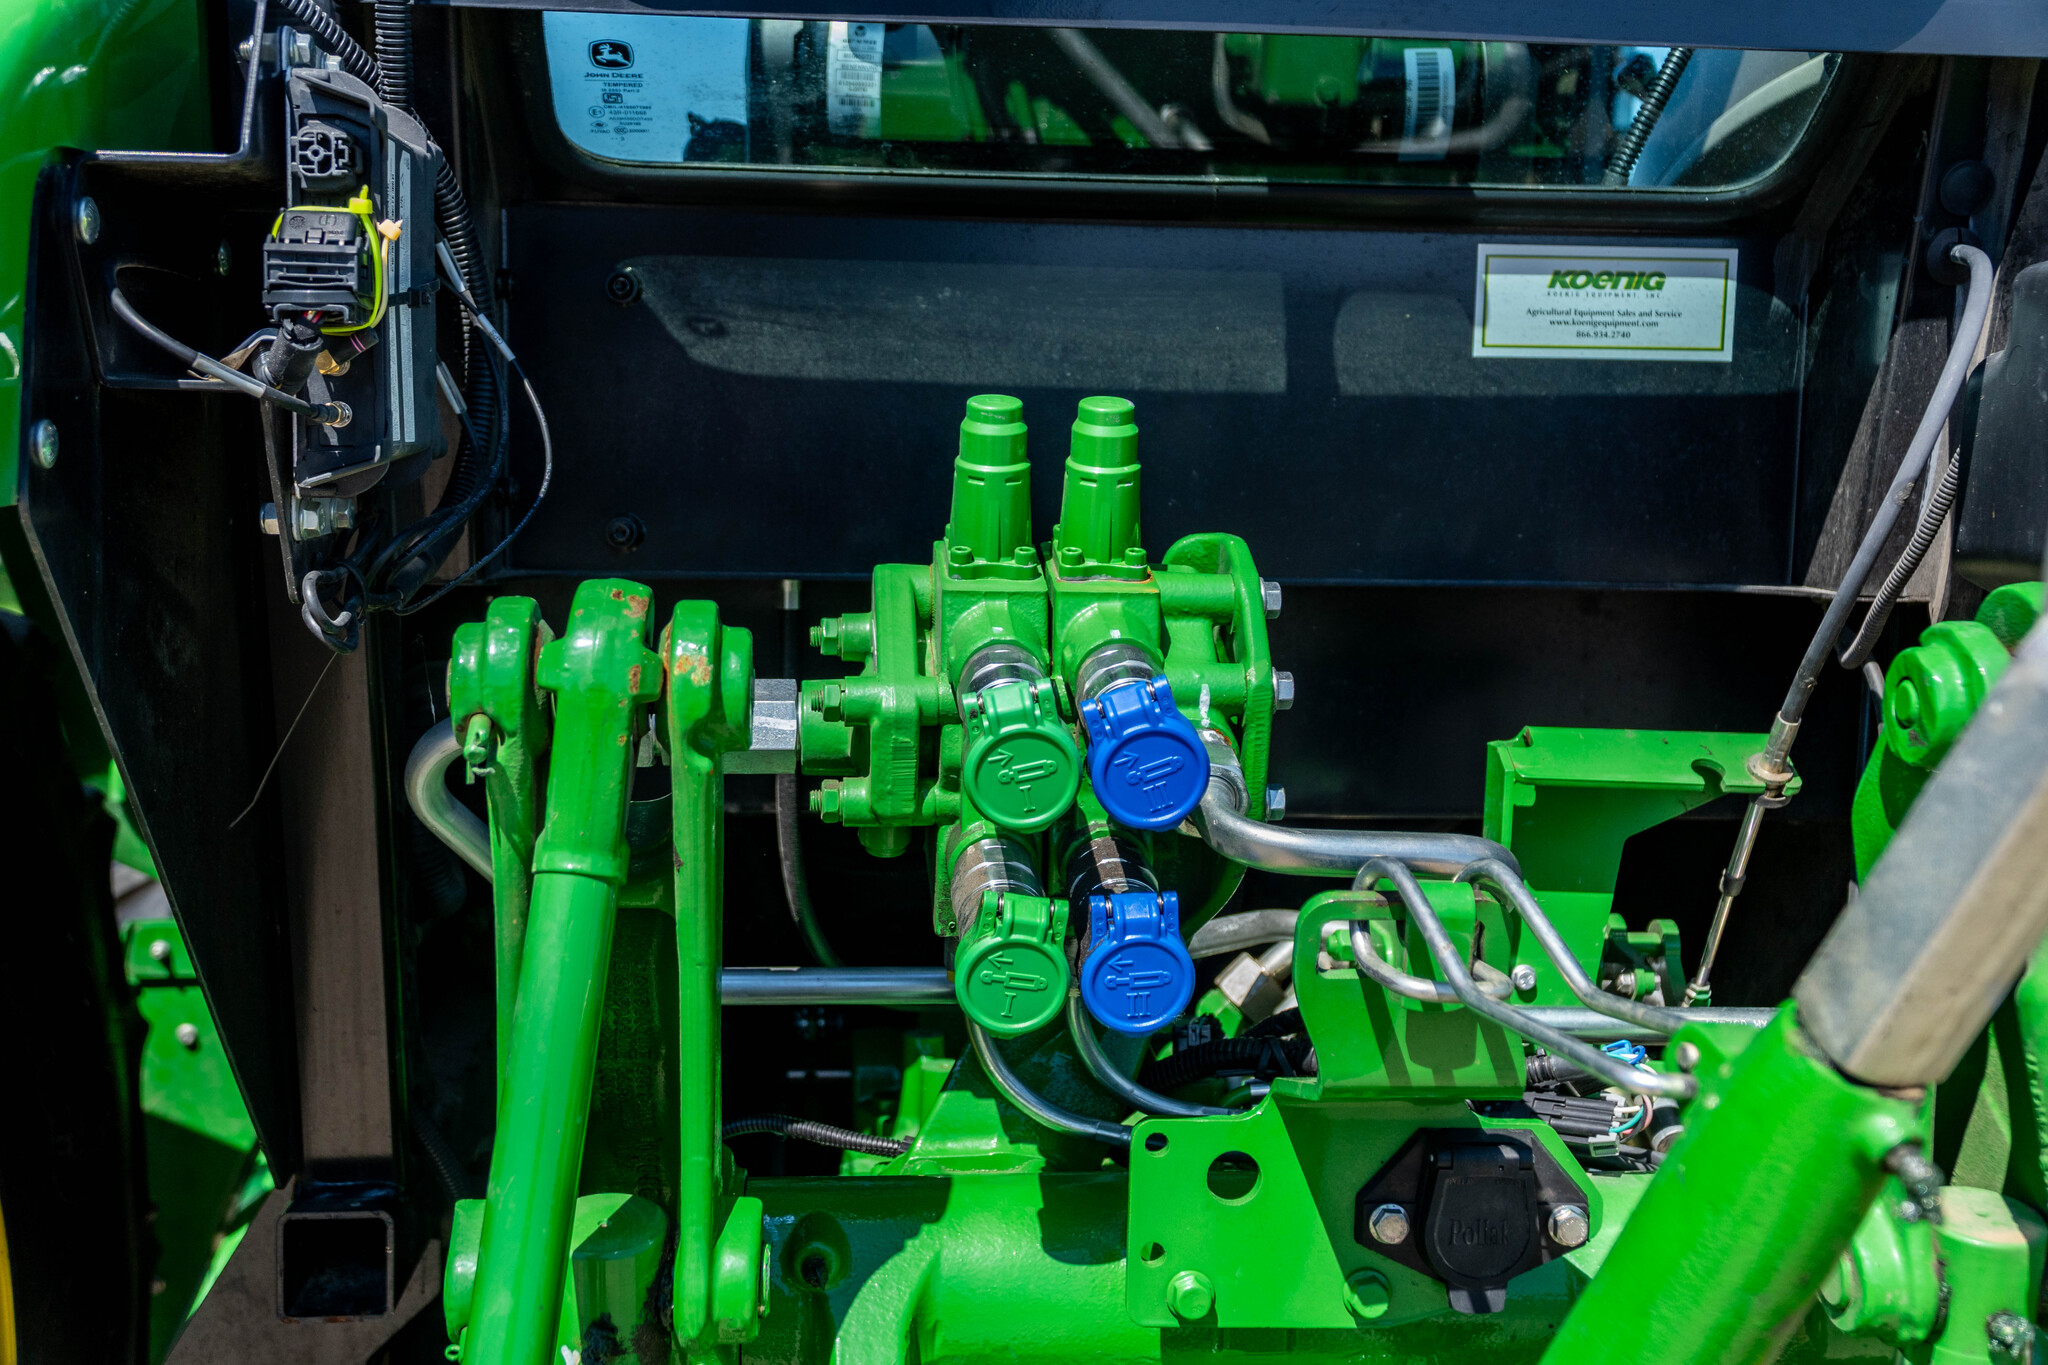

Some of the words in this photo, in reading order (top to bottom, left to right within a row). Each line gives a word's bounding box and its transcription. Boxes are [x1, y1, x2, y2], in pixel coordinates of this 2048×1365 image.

[1526, 308, 1572, 318] Agricultural
[1574, 309, 1615, 319] Equipment
[1617, 309, 1636, 317] Sales
[1549, 318, 1659, 328] www.koenigequipment.com
[490, 329, 504, 345] GPS
[1576, 330, 1631, 339] 866.934.2740
